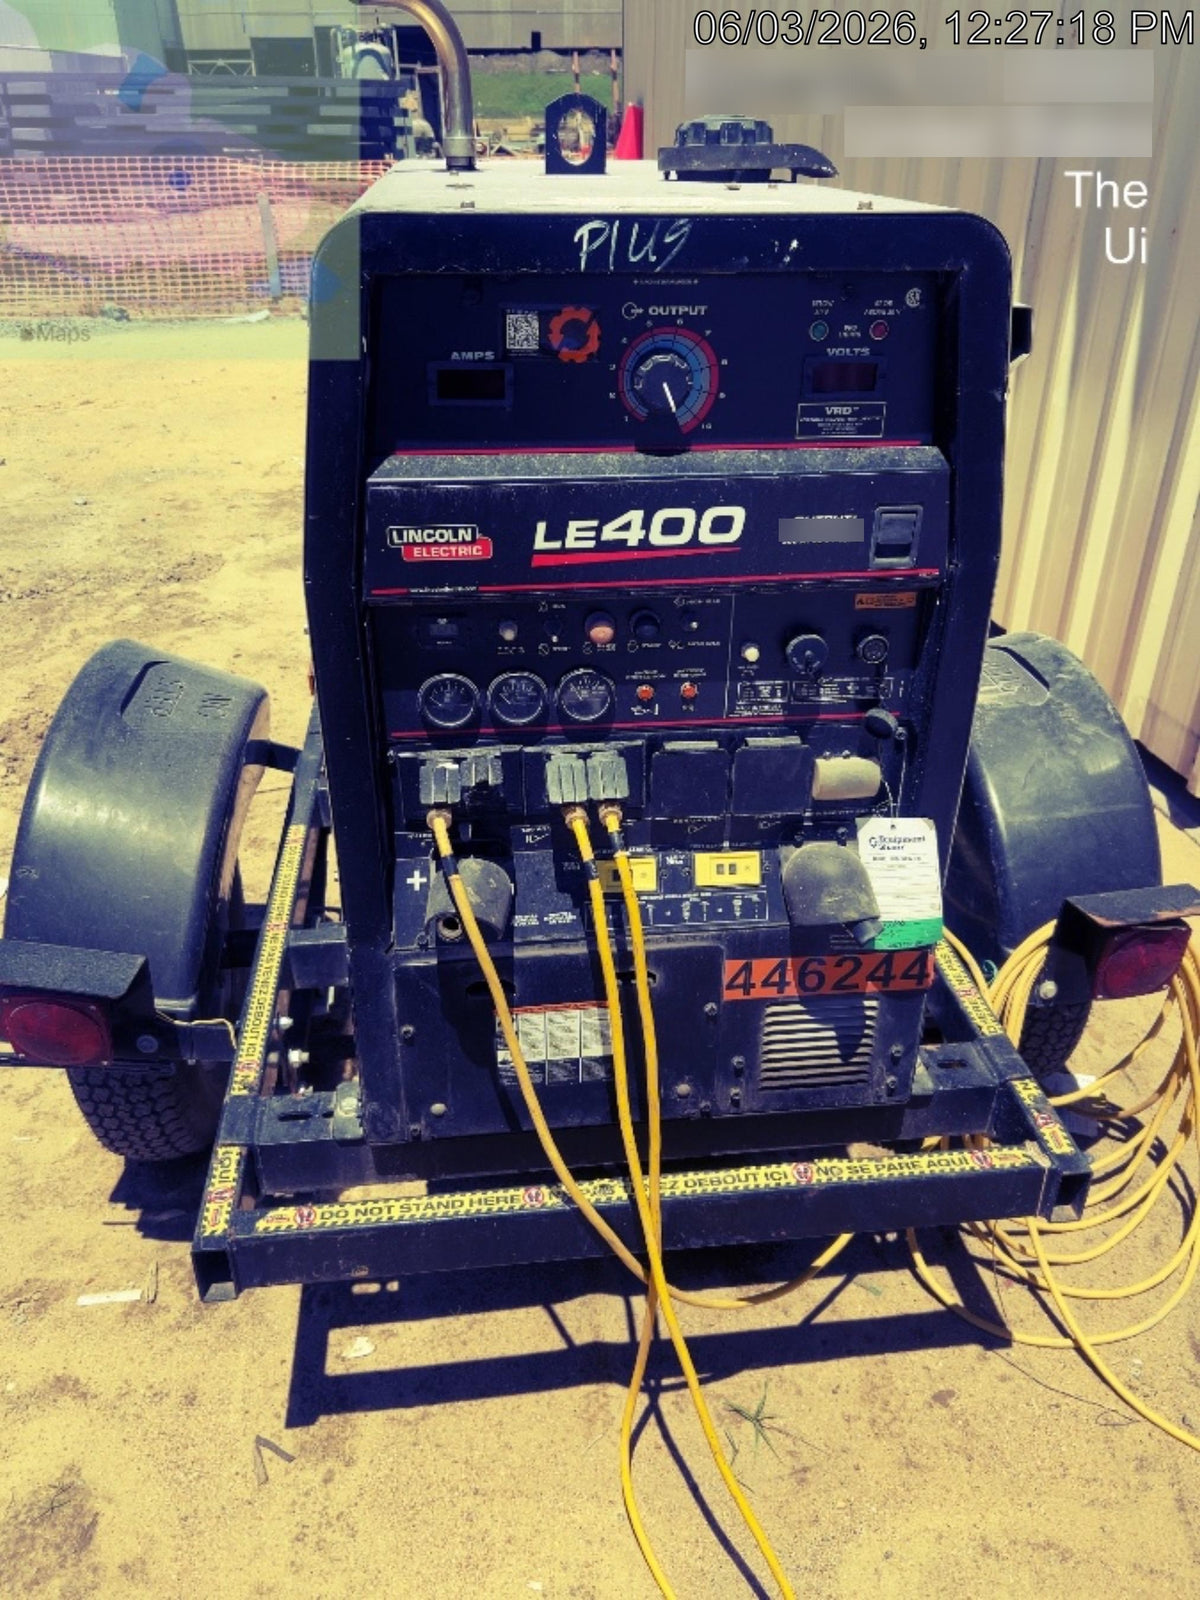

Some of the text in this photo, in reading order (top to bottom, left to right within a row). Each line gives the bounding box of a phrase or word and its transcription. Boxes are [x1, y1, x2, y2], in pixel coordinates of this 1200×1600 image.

[648, 304, 708, 316] OUTPUT
[450, 350, 496, 362] AMPS
[826, 346, 871, 357] VOLTS
[392, 527, 472, 544] LINCOLN
[533, 506, 746, 553] LE400
[413, 545, 482, 558] ELECTRIC
[725, 950, 931, 999] 446244
[320, 1209, 349, 1221] DO
[354, 1205, 395, 1217] NOT
[399, 1199, 467, 1214] STAND
[469, 1194, 521, 1209] HERE
[684, 1170, 760, 1188] DEBOUT
[764, 1169, 788, 1182] ICI
[816, 1164, 843, 1178] NO
[848, 1162, 871, 1174] SE
[875, 1159, 923, 1173] PARE
